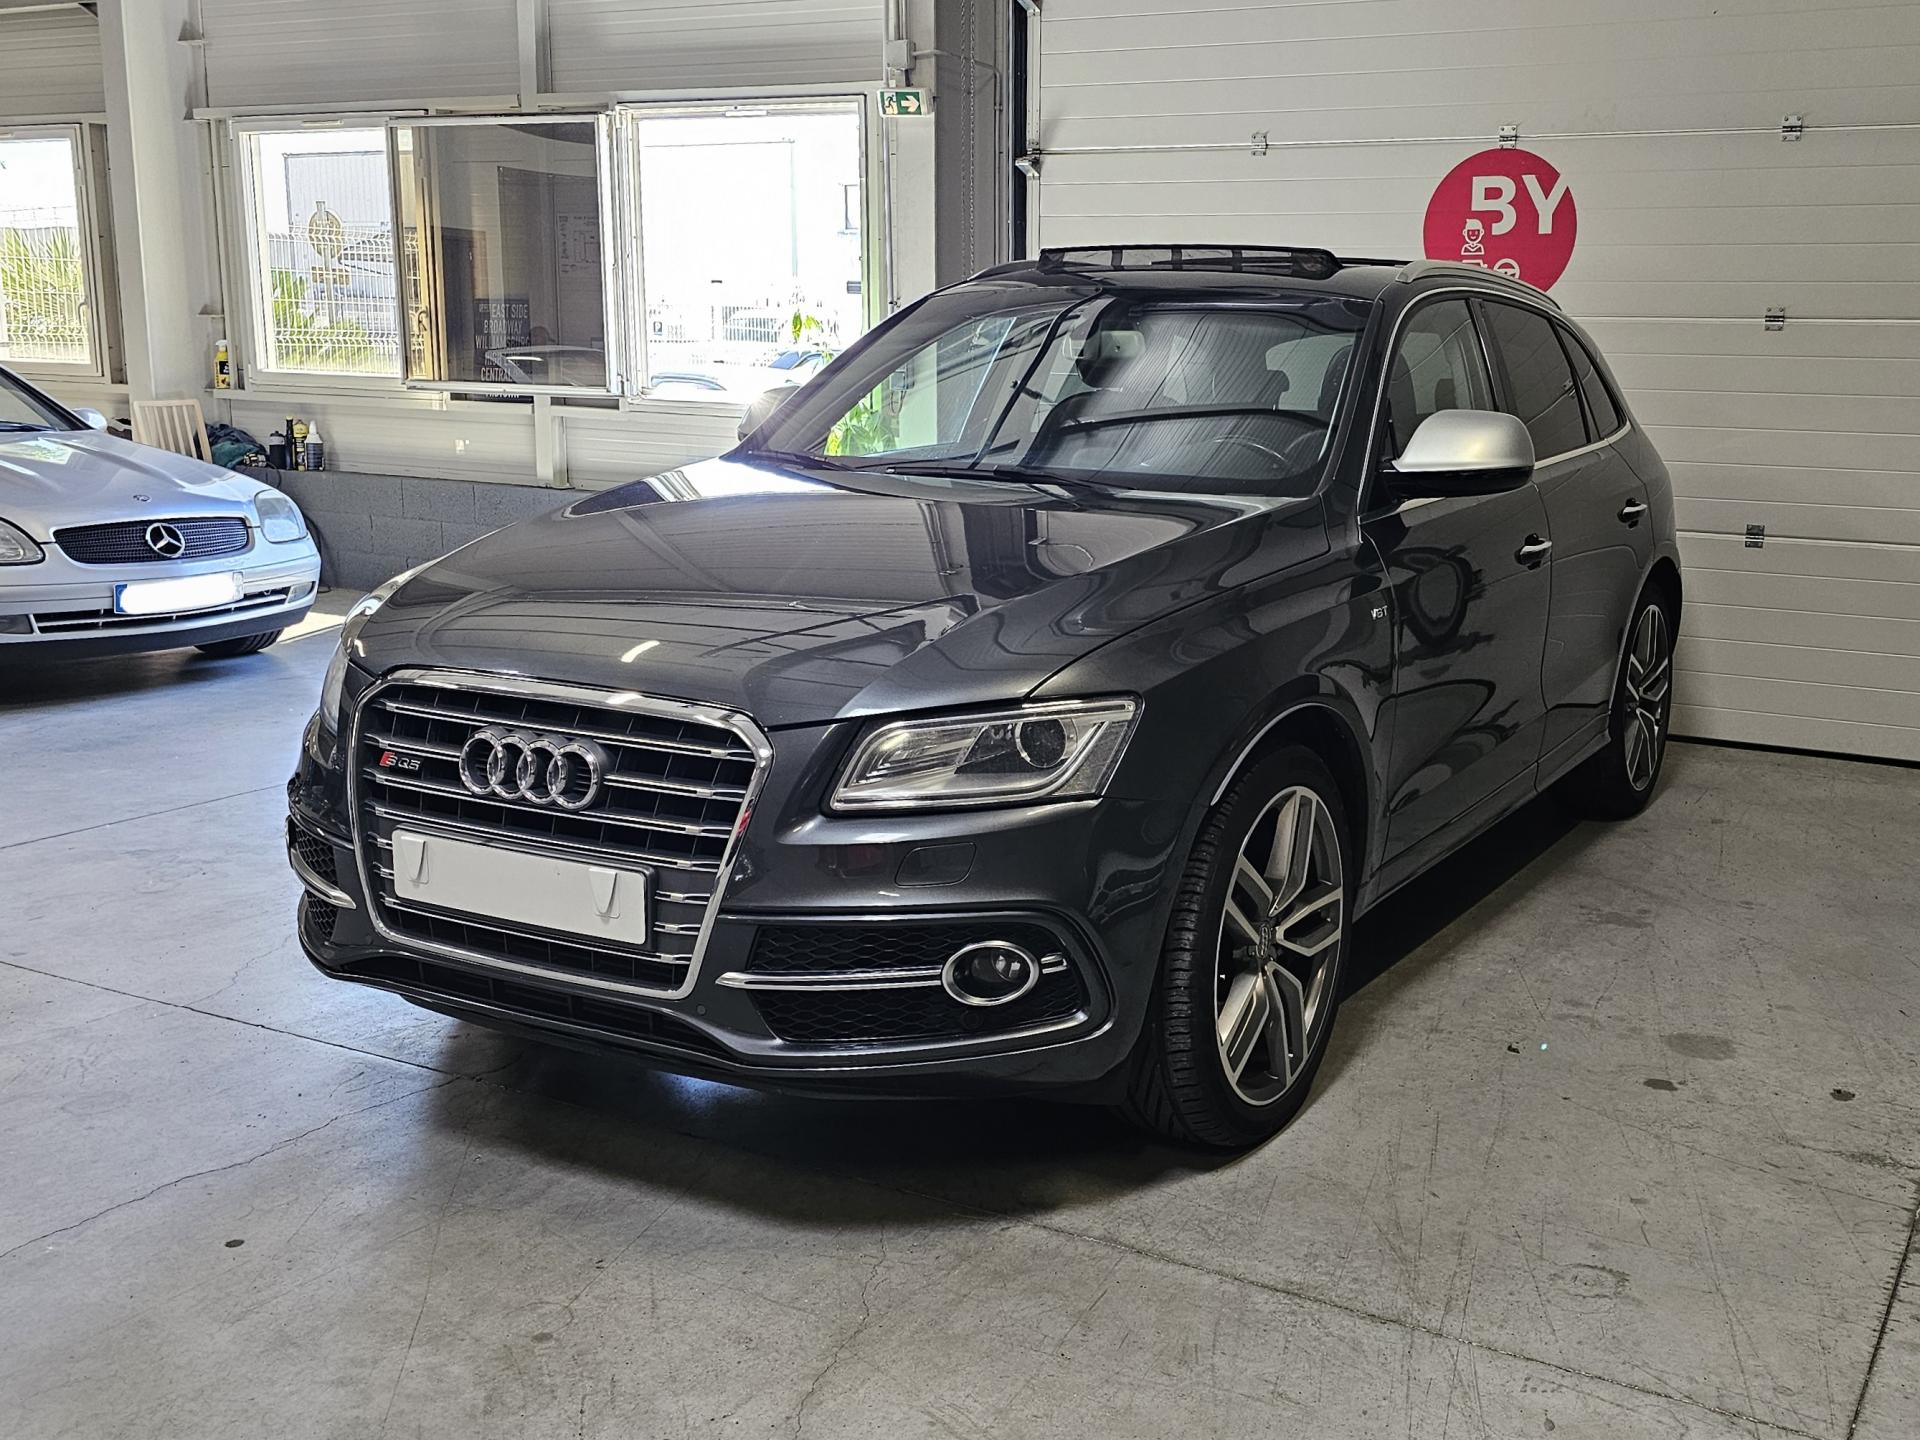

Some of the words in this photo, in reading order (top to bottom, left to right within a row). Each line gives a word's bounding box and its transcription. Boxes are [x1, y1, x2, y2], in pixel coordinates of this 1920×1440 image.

[1471, 174, 1568, 236] BY
[491, 303, 509, 318] EAST
[511, 303, 528, 319] SIDE
[484, 319, 522, 335] BROADWAY
[384, 754, 421, 770] SQ5
